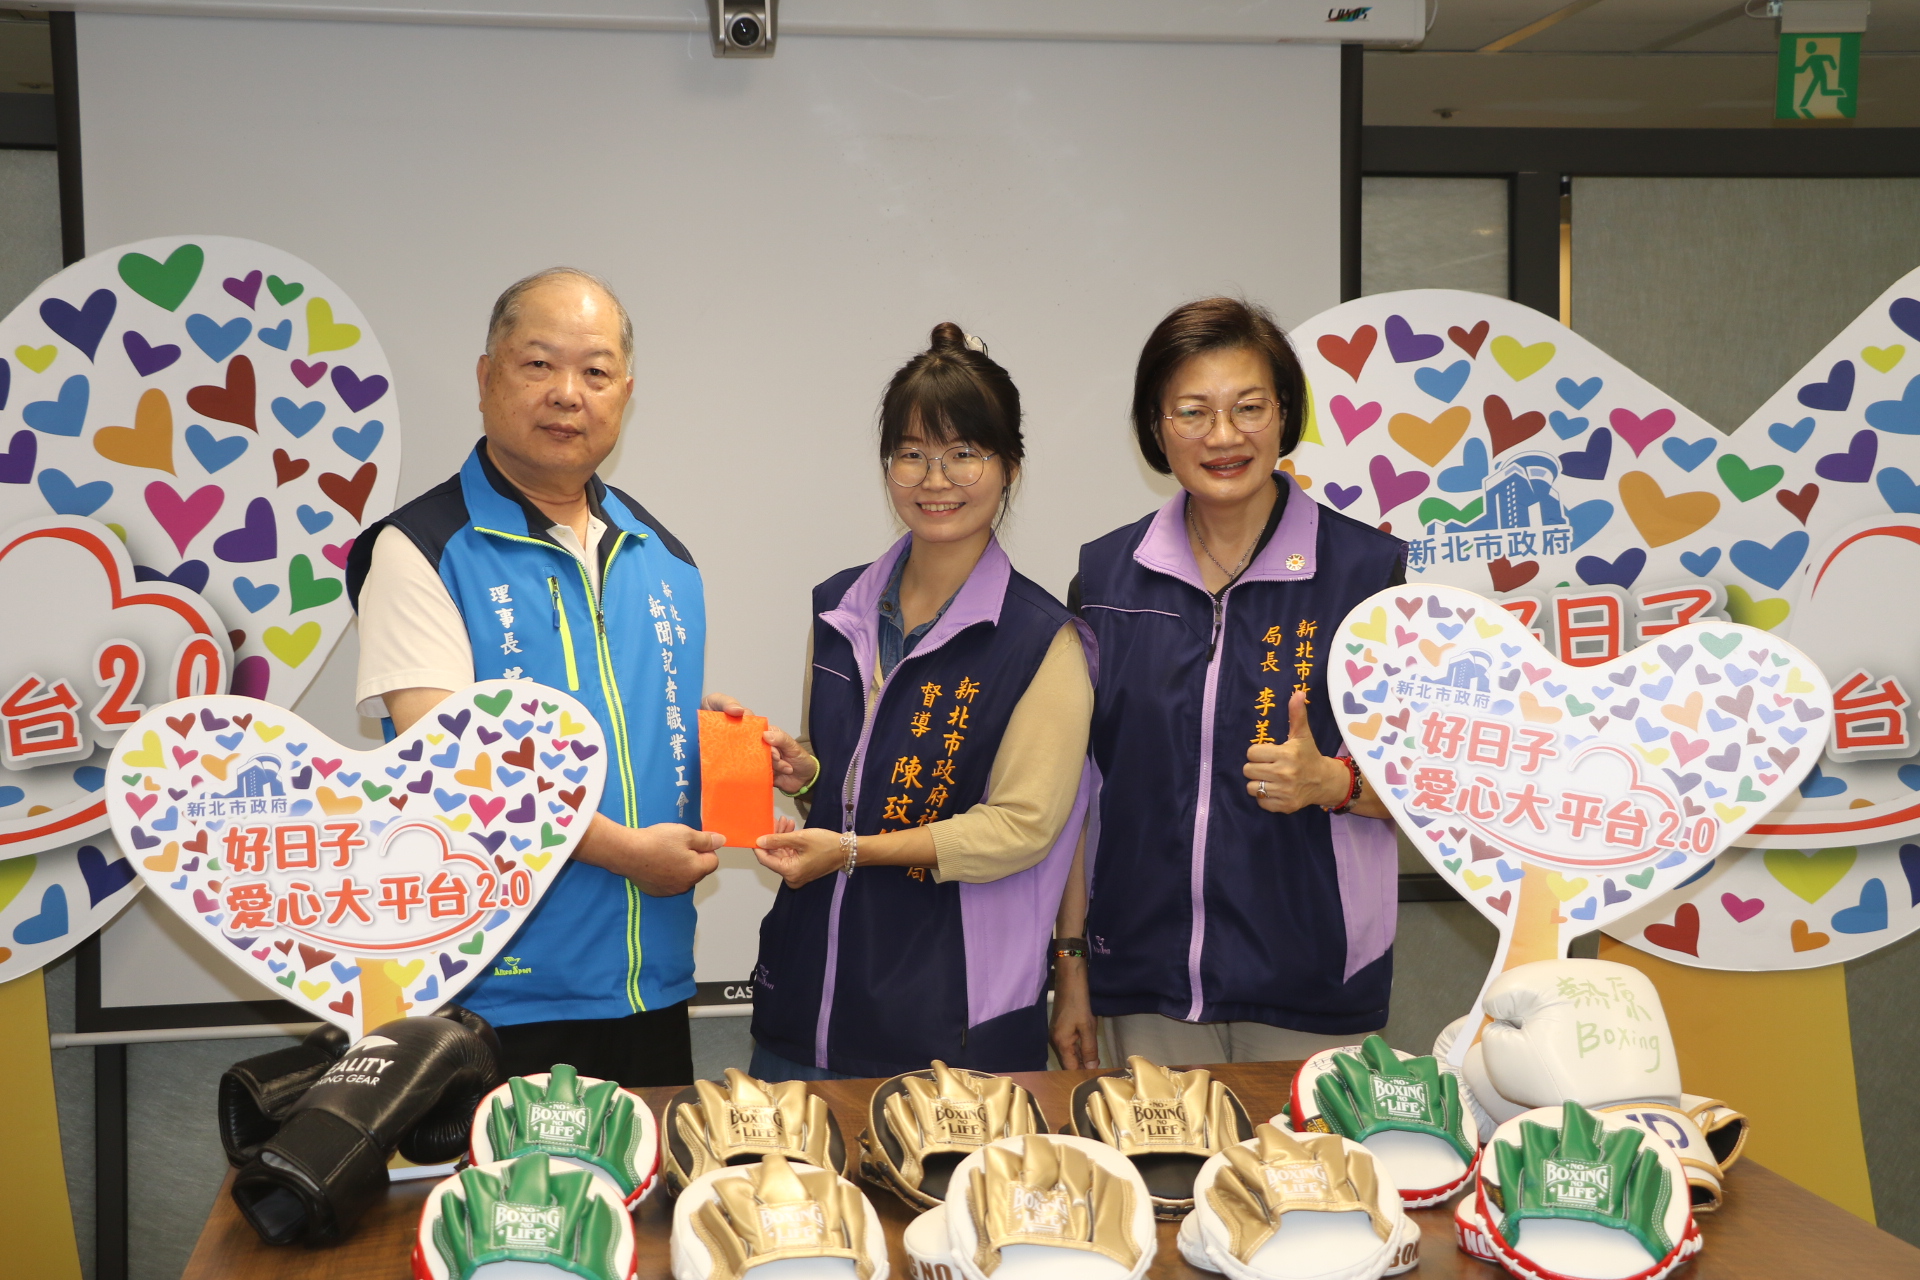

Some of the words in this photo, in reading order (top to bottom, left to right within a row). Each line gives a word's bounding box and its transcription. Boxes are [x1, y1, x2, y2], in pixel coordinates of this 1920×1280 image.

[1408, 528, 1571, 566] 新北市政府
[489, 584, 523, 655] 理事長
[661, 580, 687, 645] 新北市
[1260, 625, 1282, 673] 局長
[648, 594, 689, 818] 新聞記者職業工會
[1396, 680, 1491, 709] 新北市政府
[911, 682, 943, 738] 督導
[1833, 672, 1906, 749] 台
[1421, 711, 1557, 772] 好日子
[879, 755, 923, 835] 陳玟
[187, 797, 288, 817] 新北市政府
[222, 823, 366, 872] 好日子
[1576, 1020, 1660, 1073] Boxing
[346, 1074, 380, 1086] GEAR
[1374, 1080, 1426, 1104] BOXING
[530, 1106, 586, 1127] BOXING
[935, 1106, 987, 1123] BOXING
[1133, 1105, 1187, 1123] BOXING
[1387, 1099, 1420, 1113] LIFE
[540, 1123, 575, 1137] LIFE
[743, 1127, 776, 1137] LIFE
[948, 1123, 981, 1134] LIFE
[1147, 1124, 1180, 1135] LIFE
[1264, 1165, 1328, 1185] BOXING
[1546, 1164, 1609, 1189] BOXING
[1282, 1182, 1320, 1193] LIFE
[1557, 1184, 1597, 1199] LIFE
[495, 1206, 560, 1229] BOXING
[506, 1225, 547, 1239] LIFE
